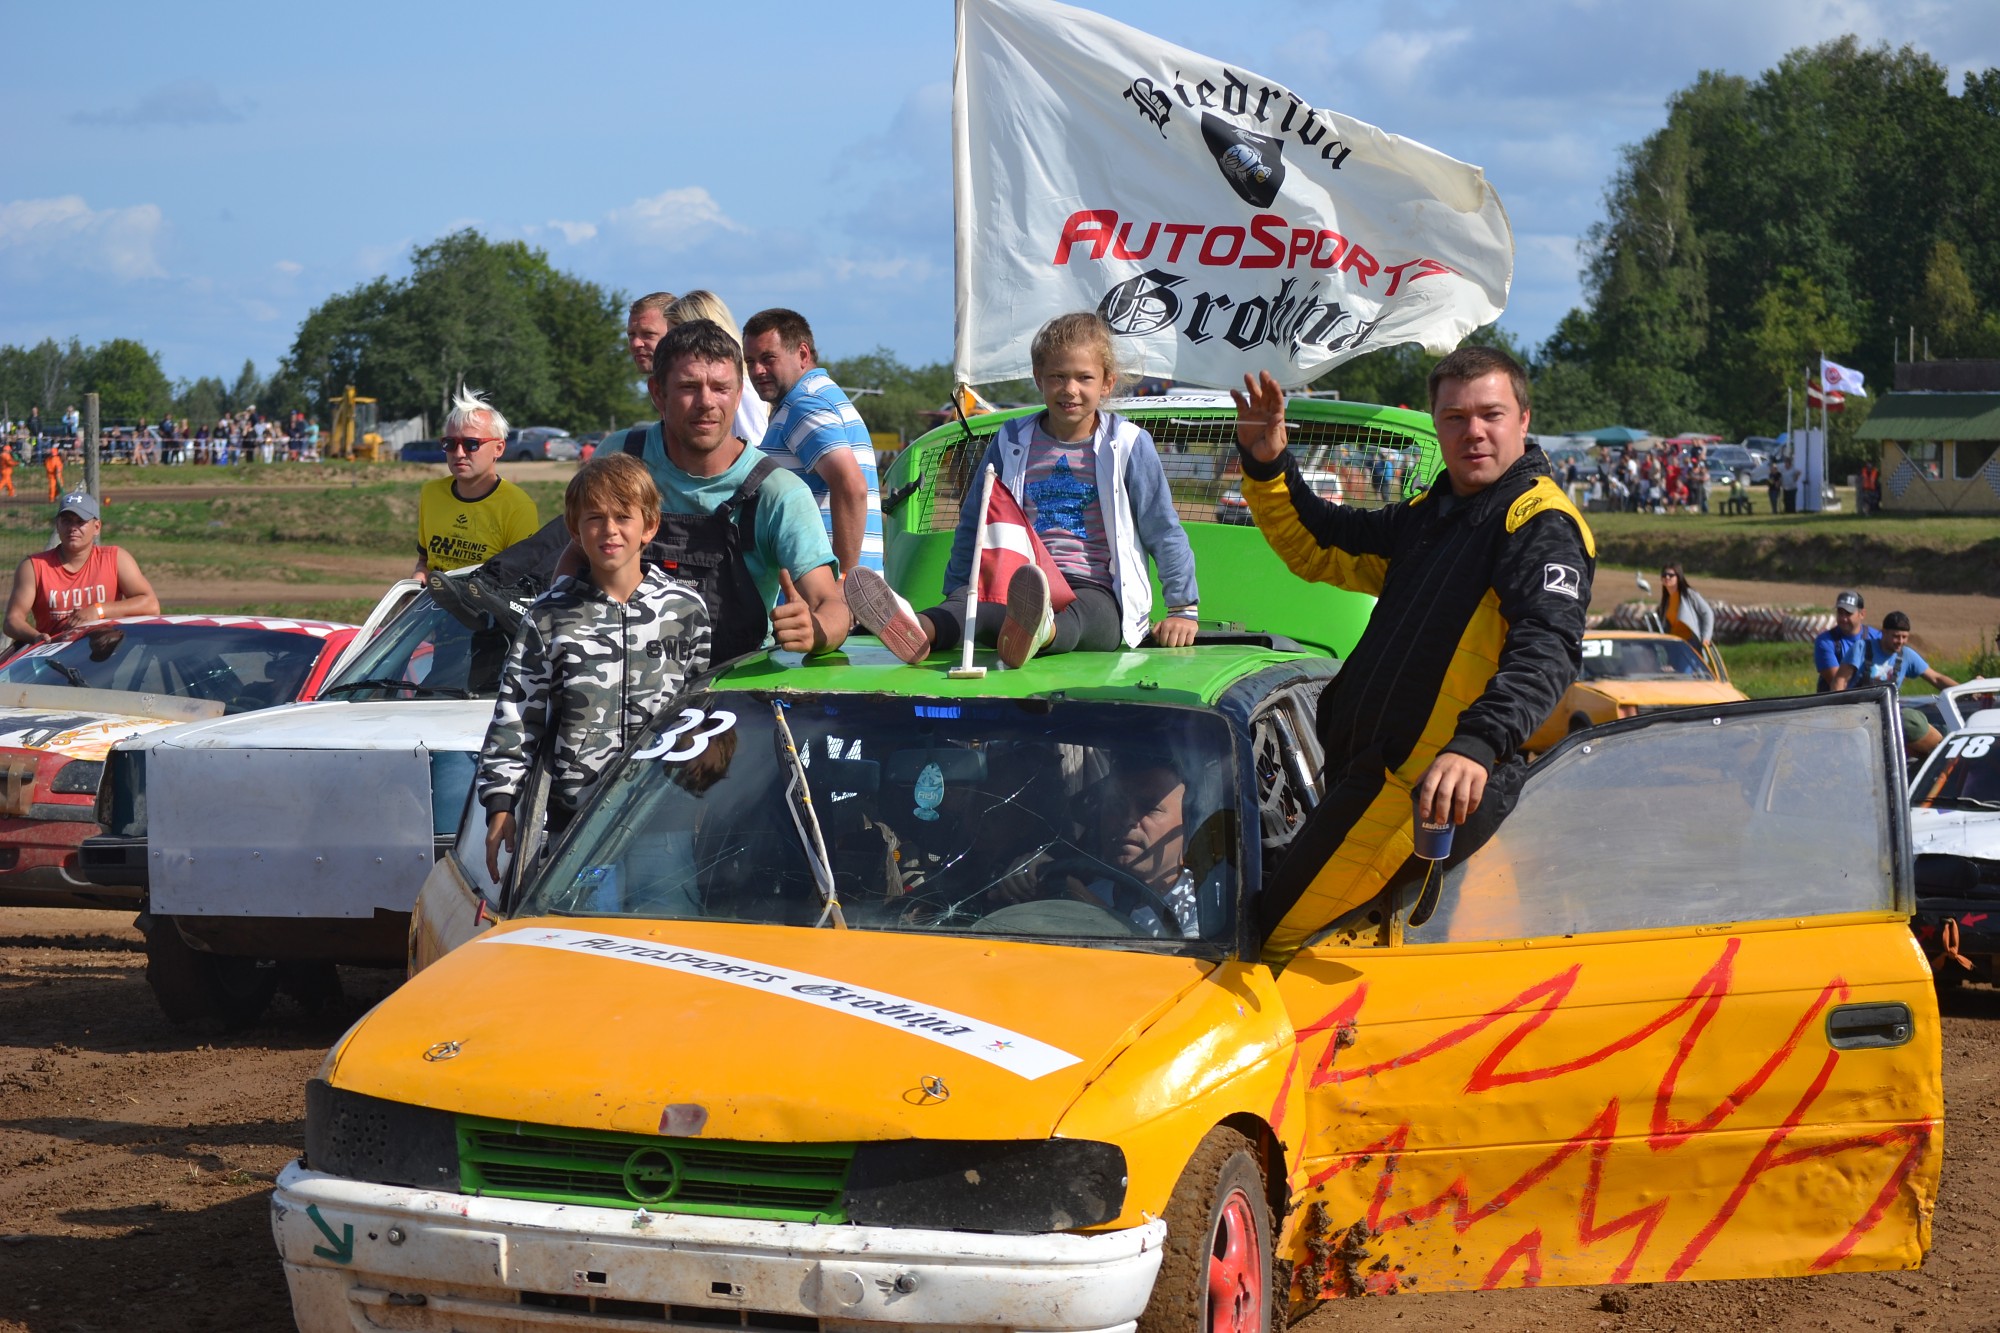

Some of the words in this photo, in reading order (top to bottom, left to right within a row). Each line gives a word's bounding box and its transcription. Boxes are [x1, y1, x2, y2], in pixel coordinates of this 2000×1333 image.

[452, 549, 483, 561] NITISS
[456, 539, 488, 553] REINIS
[48, 584, 107, 609] KYOTO
[1581, 639, 1613, 658] 31
[630, 707, 738, 762] 33
[1944, 734, 1996, 759] 18
